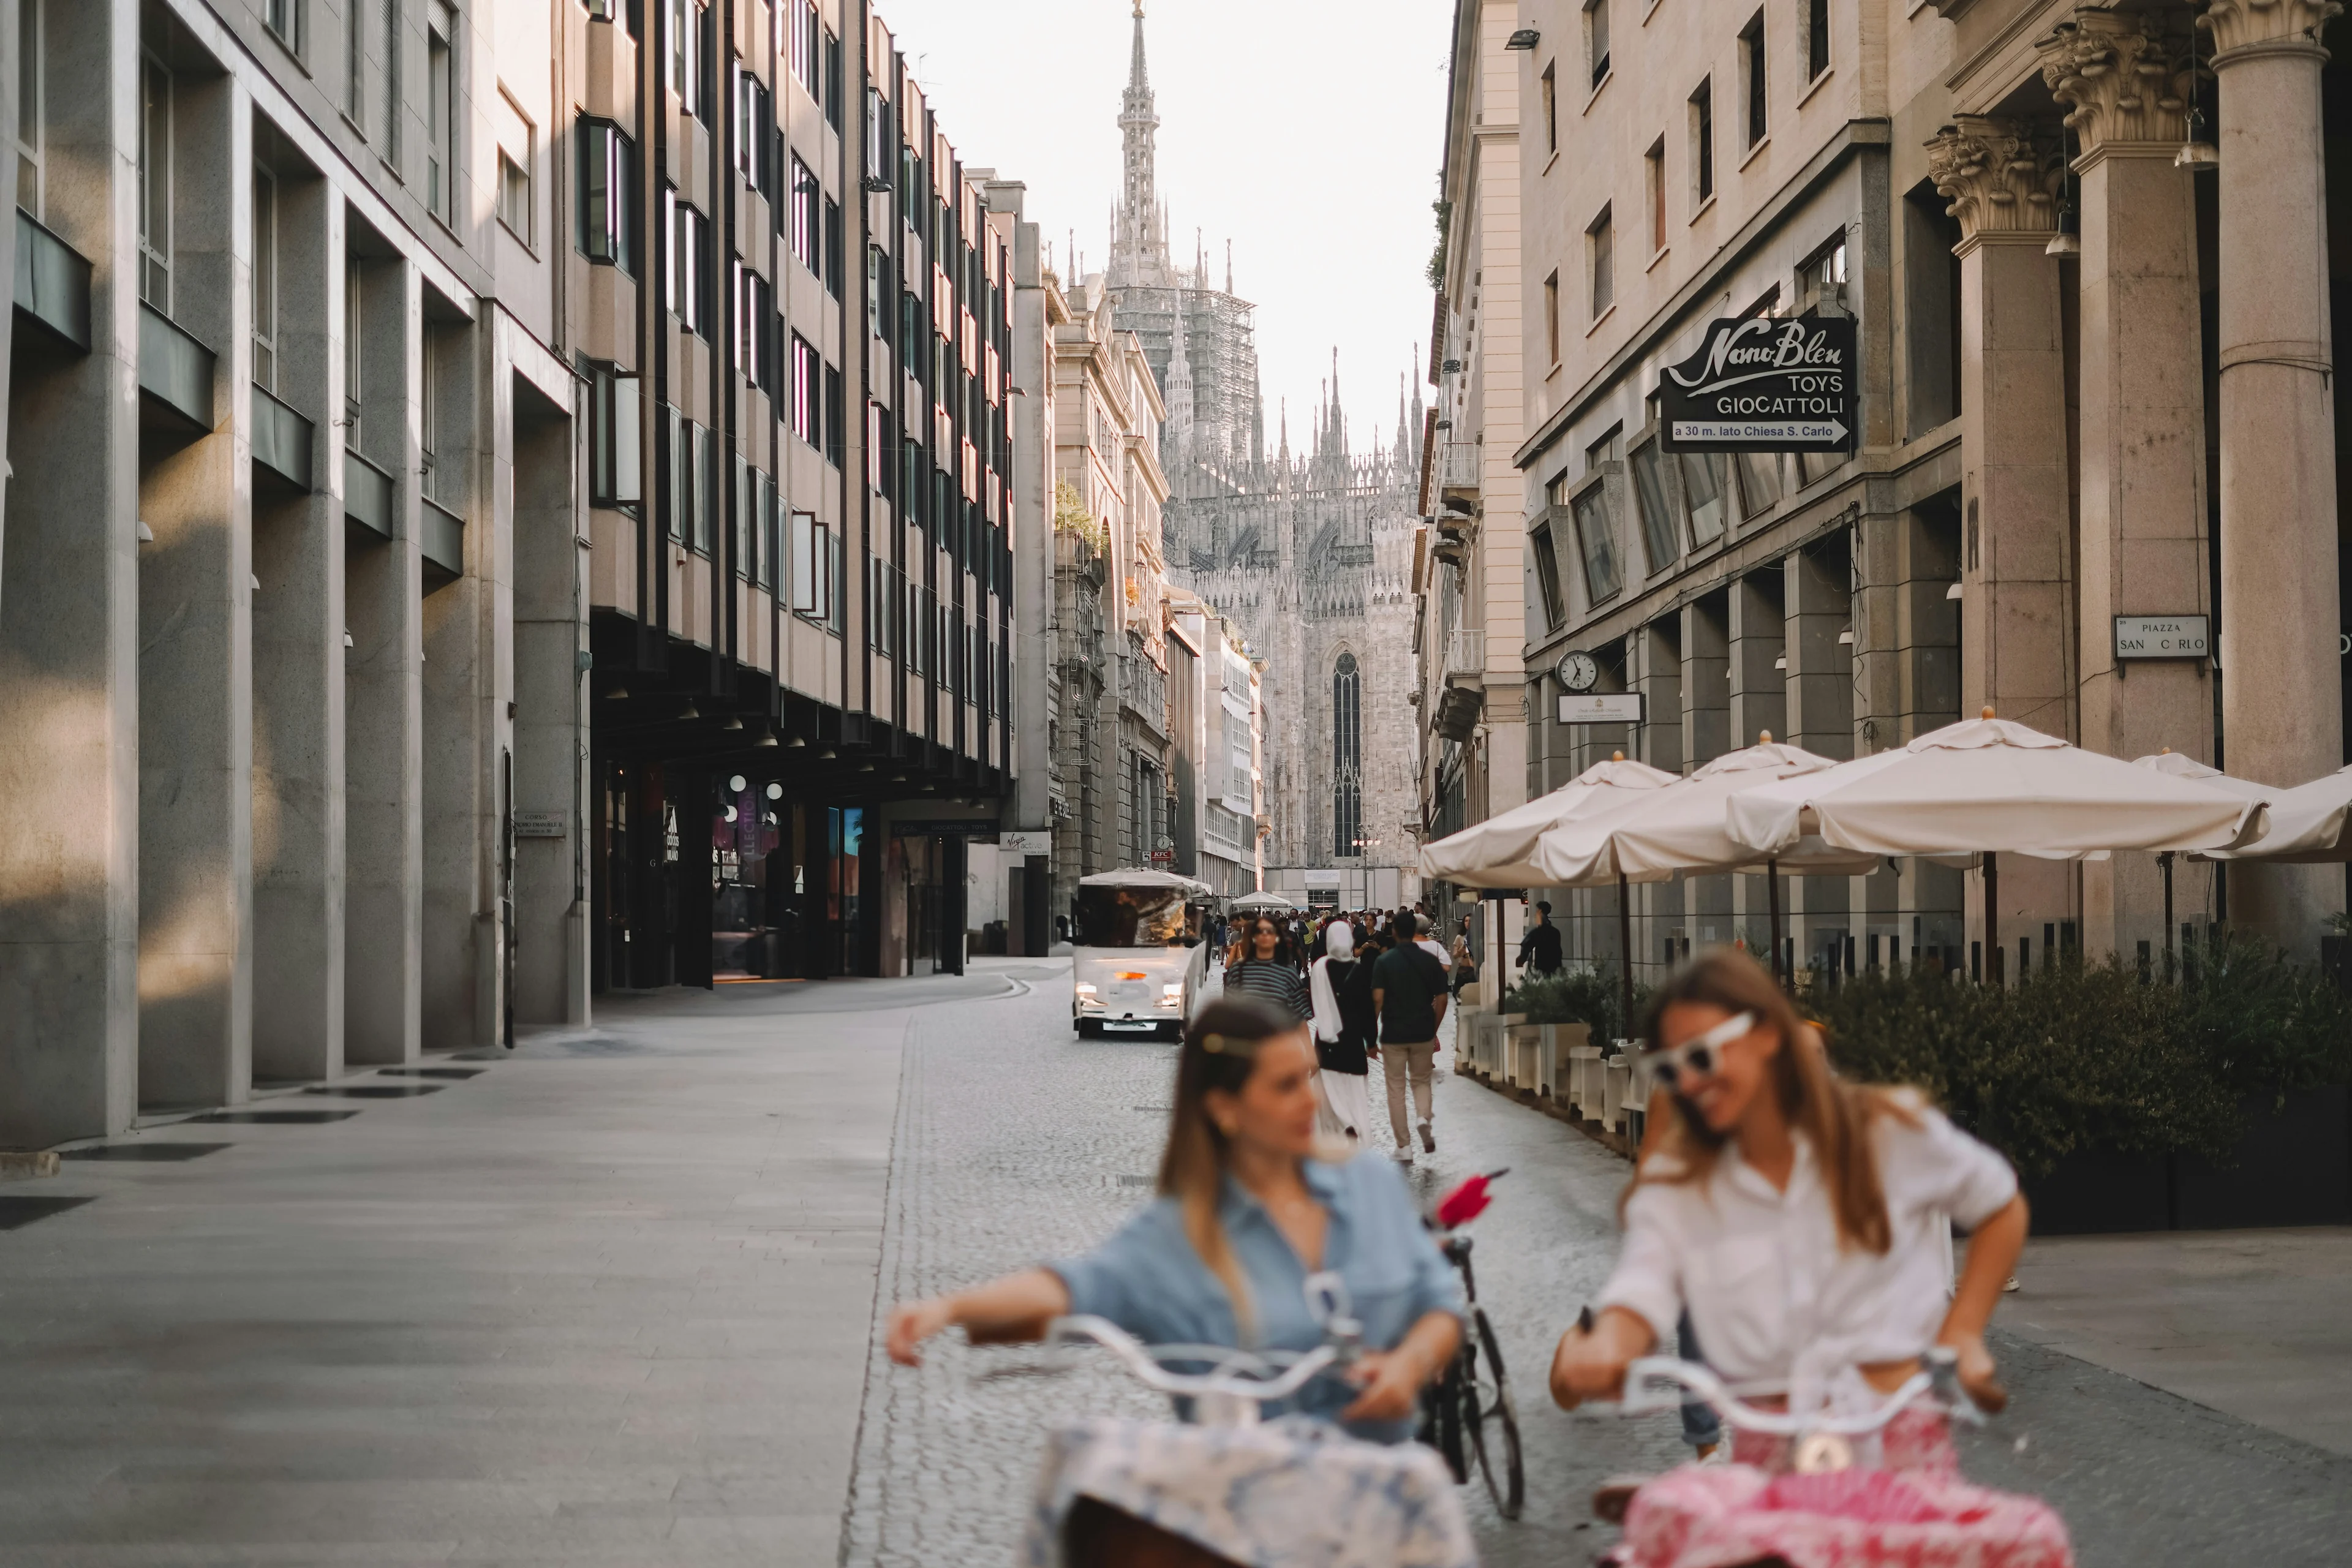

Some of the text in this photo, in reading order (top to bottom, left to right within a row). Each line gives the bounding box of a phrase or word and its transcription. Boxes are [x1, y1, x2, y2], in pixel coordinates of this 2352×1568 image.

[1668, 318, 1775, 386] Nano
[1788, 375, 1843, 393] TOYS
[1717, 396, 1843, 413] GIOCATTOLI
[1685, 426, 1698, 436] 30
[1719, 426, 1741, 436] lato
[1744, 426, 1784, 436] Chiesa
[1787, 426, 1798, 436] S.
[1802, 426, 1833, 436] Carlo
[2120, 639, 2204, 649] SAN CRLO
[666, 832, 679, 847] adidas
[1007, 833, 1026, 850] Virgin
